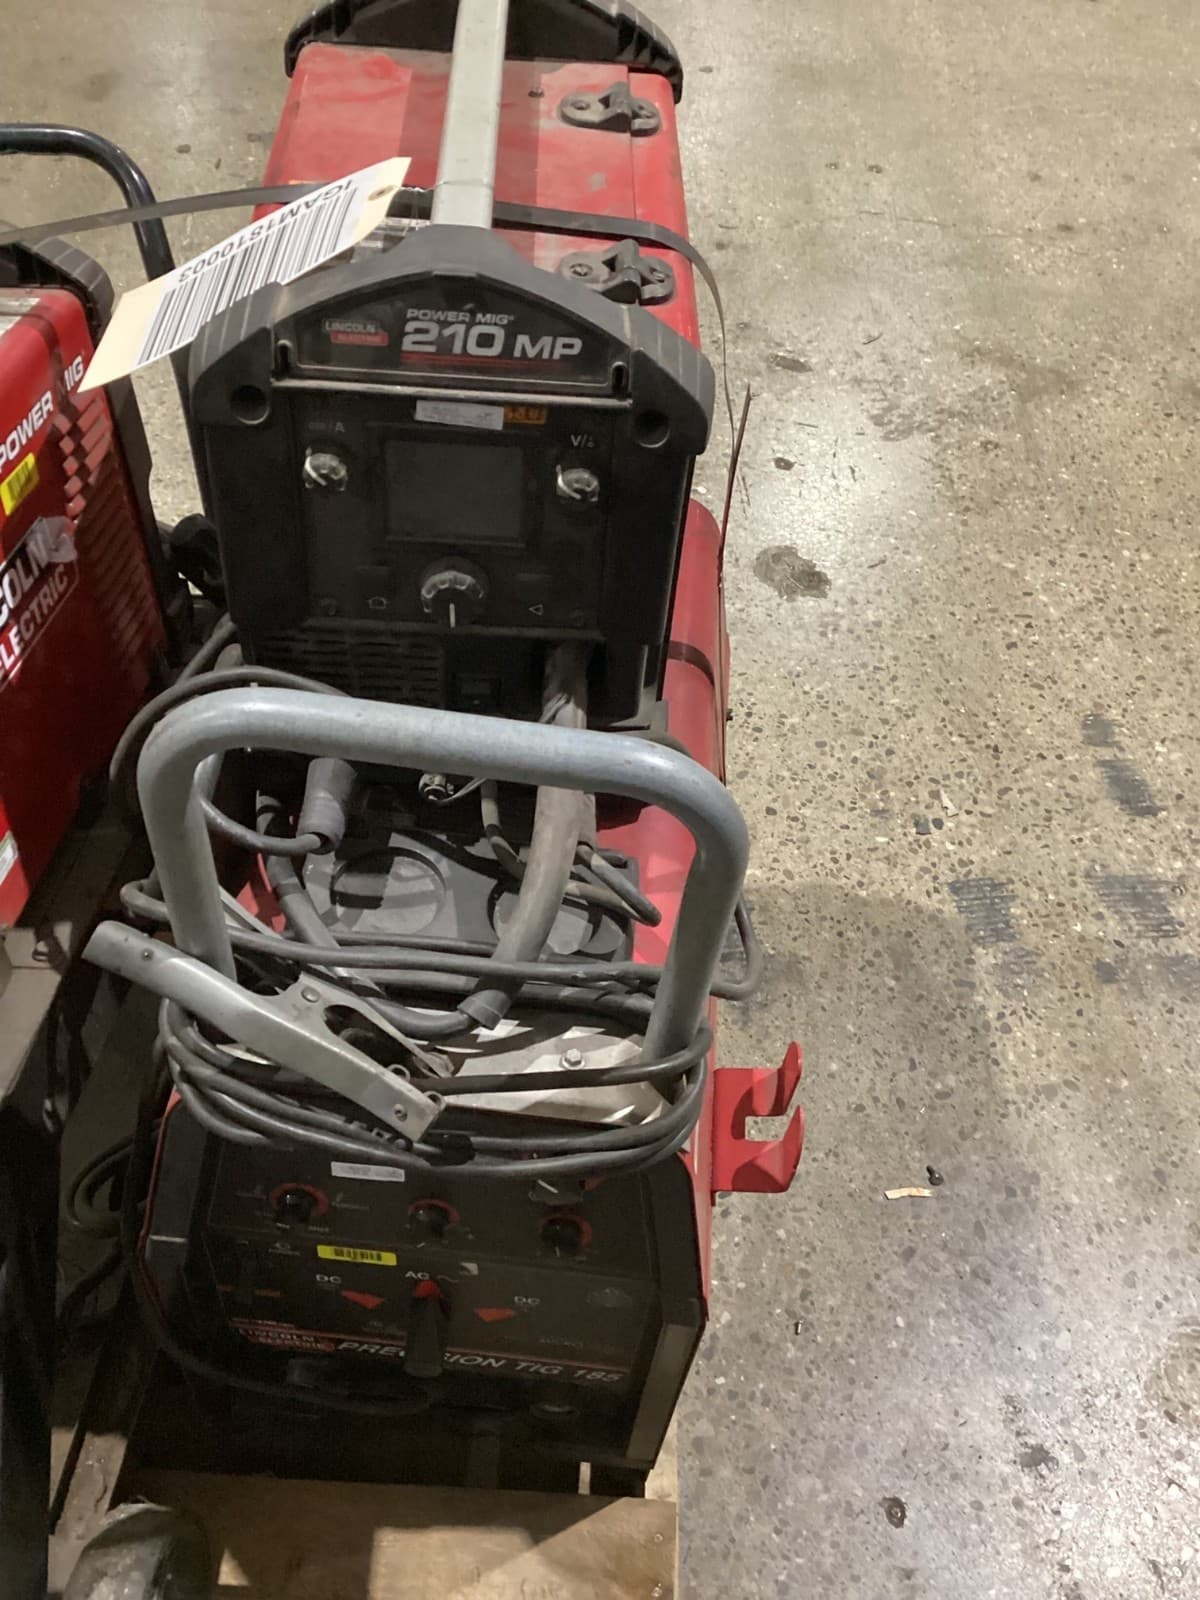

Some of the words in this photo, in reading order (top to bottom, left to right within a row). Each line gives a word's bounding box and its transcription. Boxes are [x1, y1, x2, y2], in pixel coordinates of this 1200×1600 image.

[179, 180, 353, 283] IGAM1810003
[406, 308, 470, 323] POWER
[324, 321, 377, 333] LINCOLN
[402, 320, 505, 357] 210
[512, 334, 583, 360] MP
[315, 1273, 342, 1285] DC
[513, 1295, 541, 1307] DC
[513, 1360, 563, 1375] TIG
[573, 1368, 624, 1382] 185
